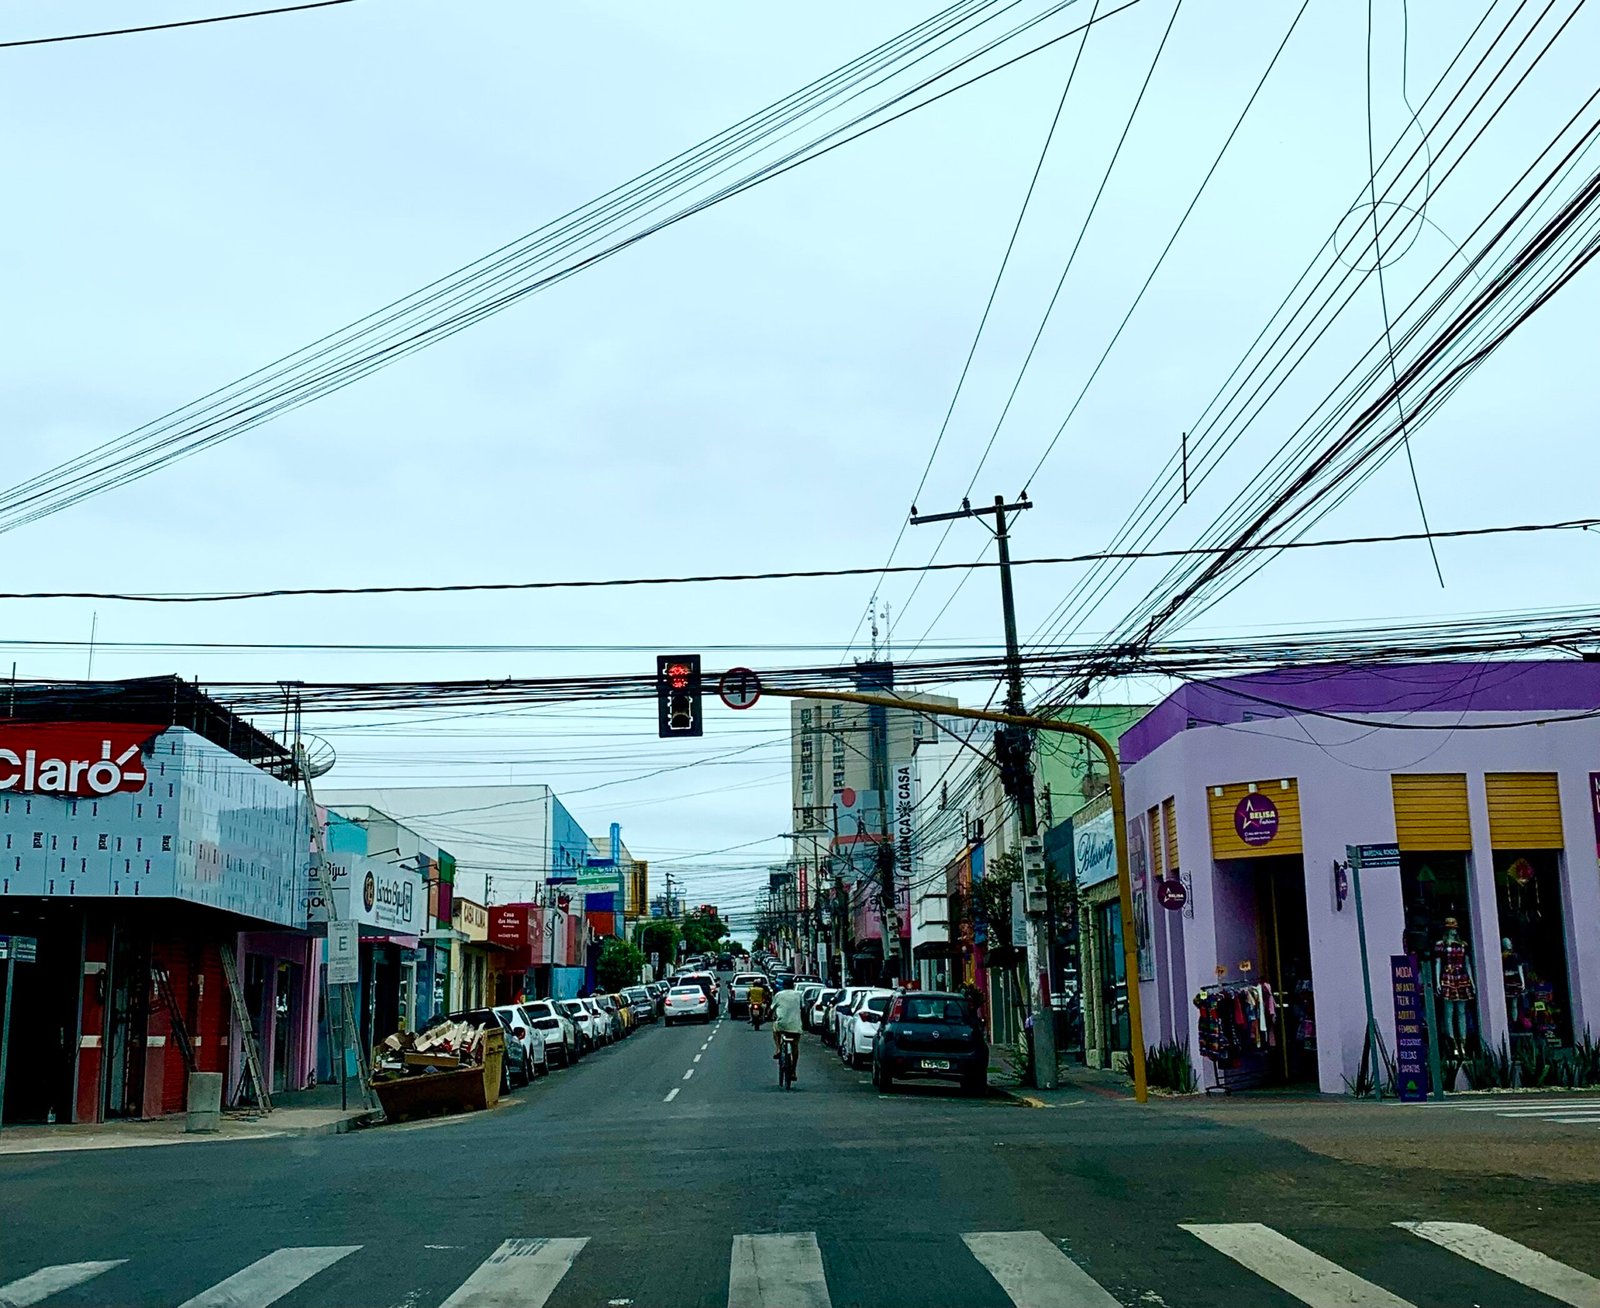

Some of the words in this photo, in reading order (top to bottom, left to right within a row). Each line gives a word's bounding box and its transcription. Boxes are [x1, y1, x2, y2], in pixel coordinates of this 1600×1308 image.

[0, 744, 122, 793] Claro
[897, 767, 911, 799] CASA
[1249, 810, 1276, 819] BELISA
[1077, 832, 1114, 874] Blessing
[338, 936, 348, 951] E
